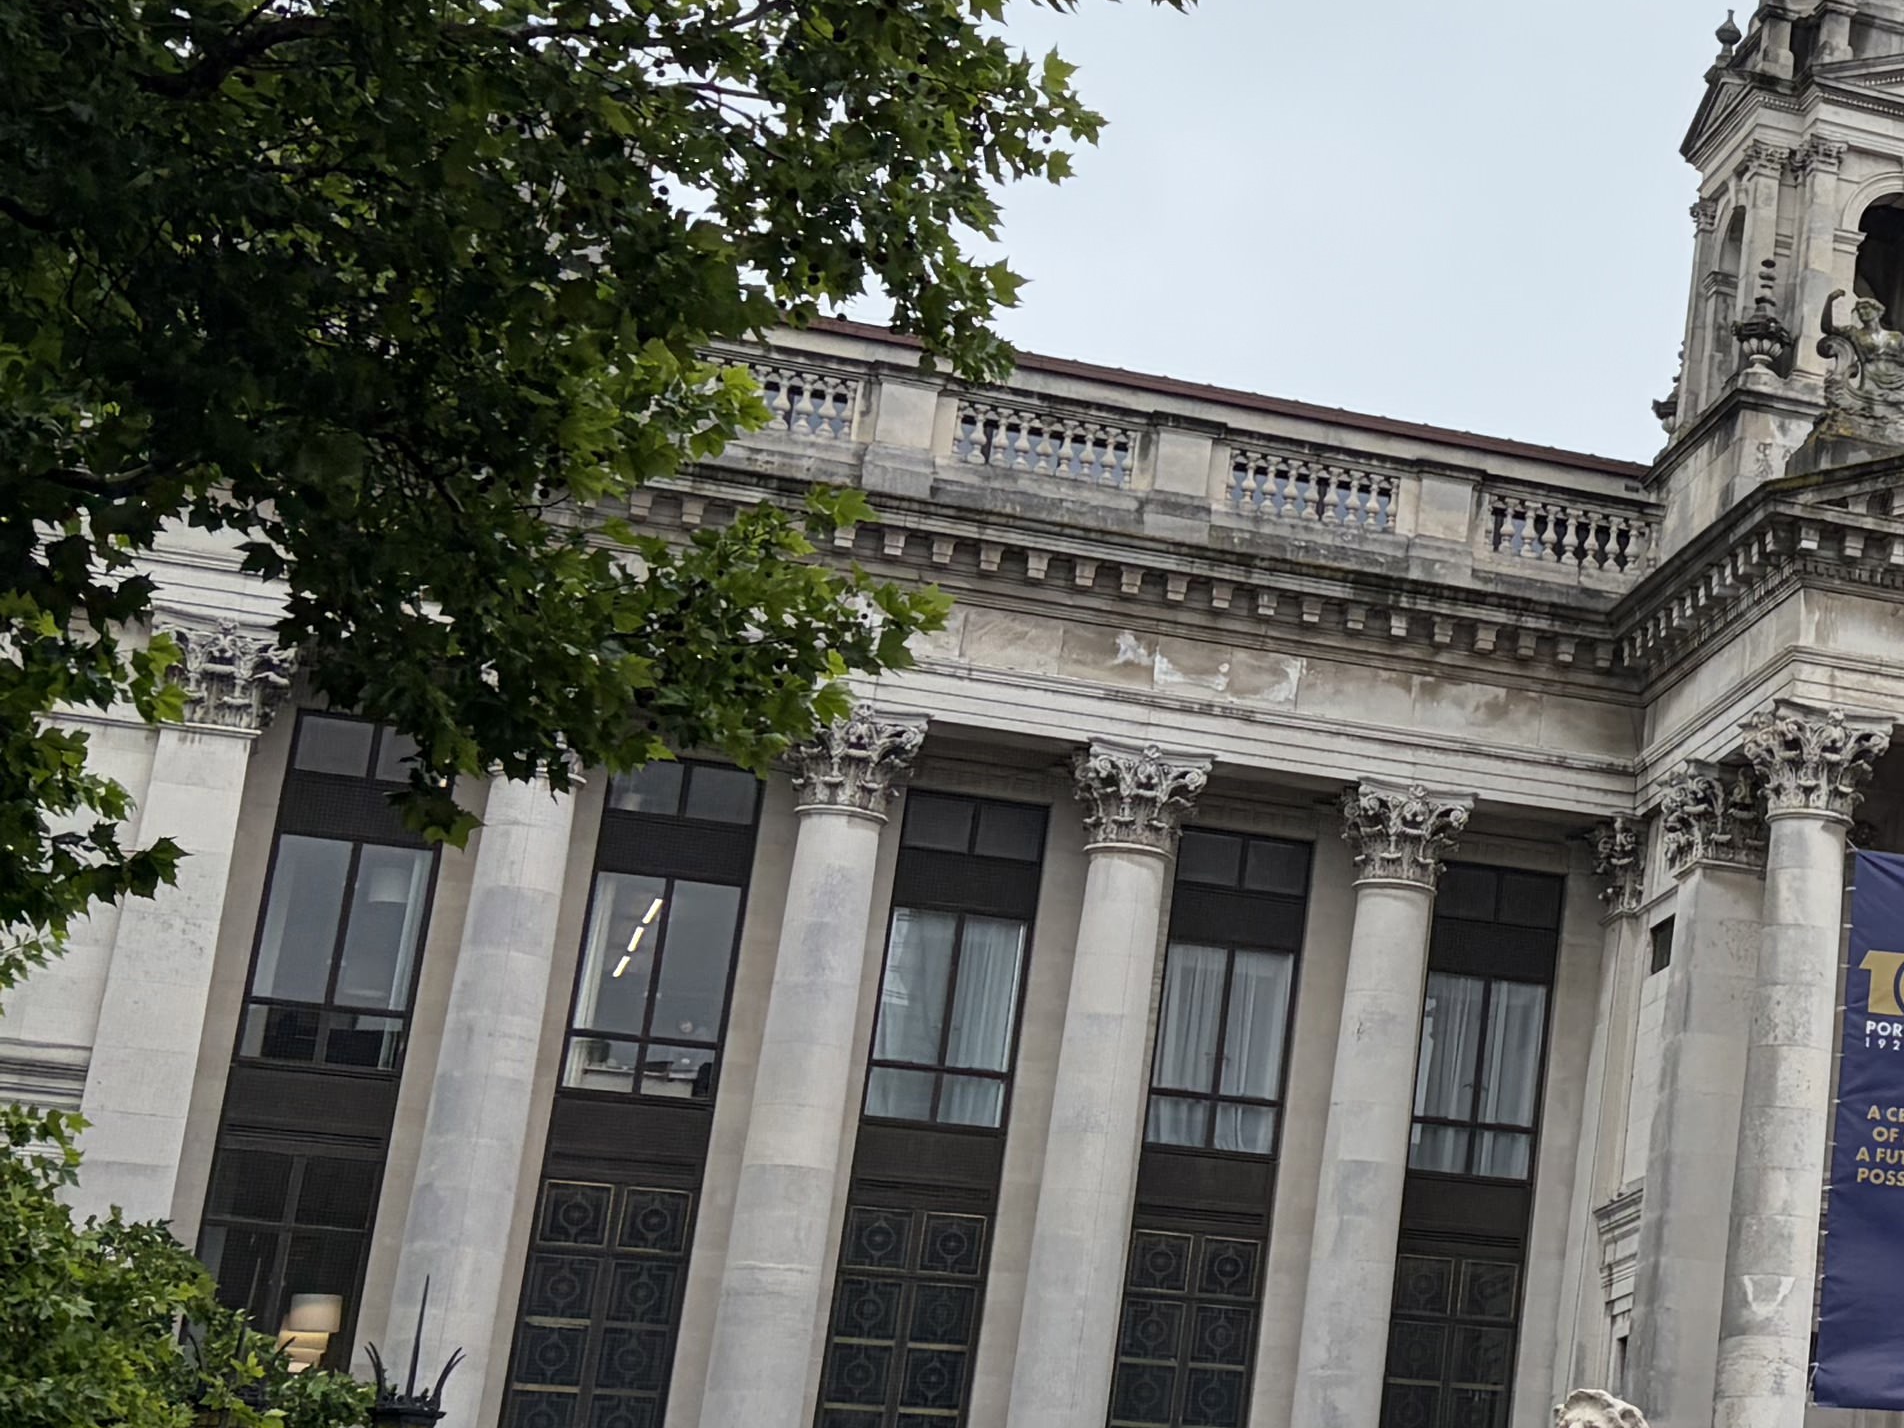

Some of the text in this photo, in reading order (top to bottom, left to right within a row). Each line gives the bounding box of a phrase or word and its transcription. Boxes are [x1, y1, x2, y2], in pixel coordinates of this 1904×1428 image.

[1867, 1104, 1881, 1121] A
[1872, 1126, 1900, 1143] OF
[1855, 1146, 1870, 1162] A
